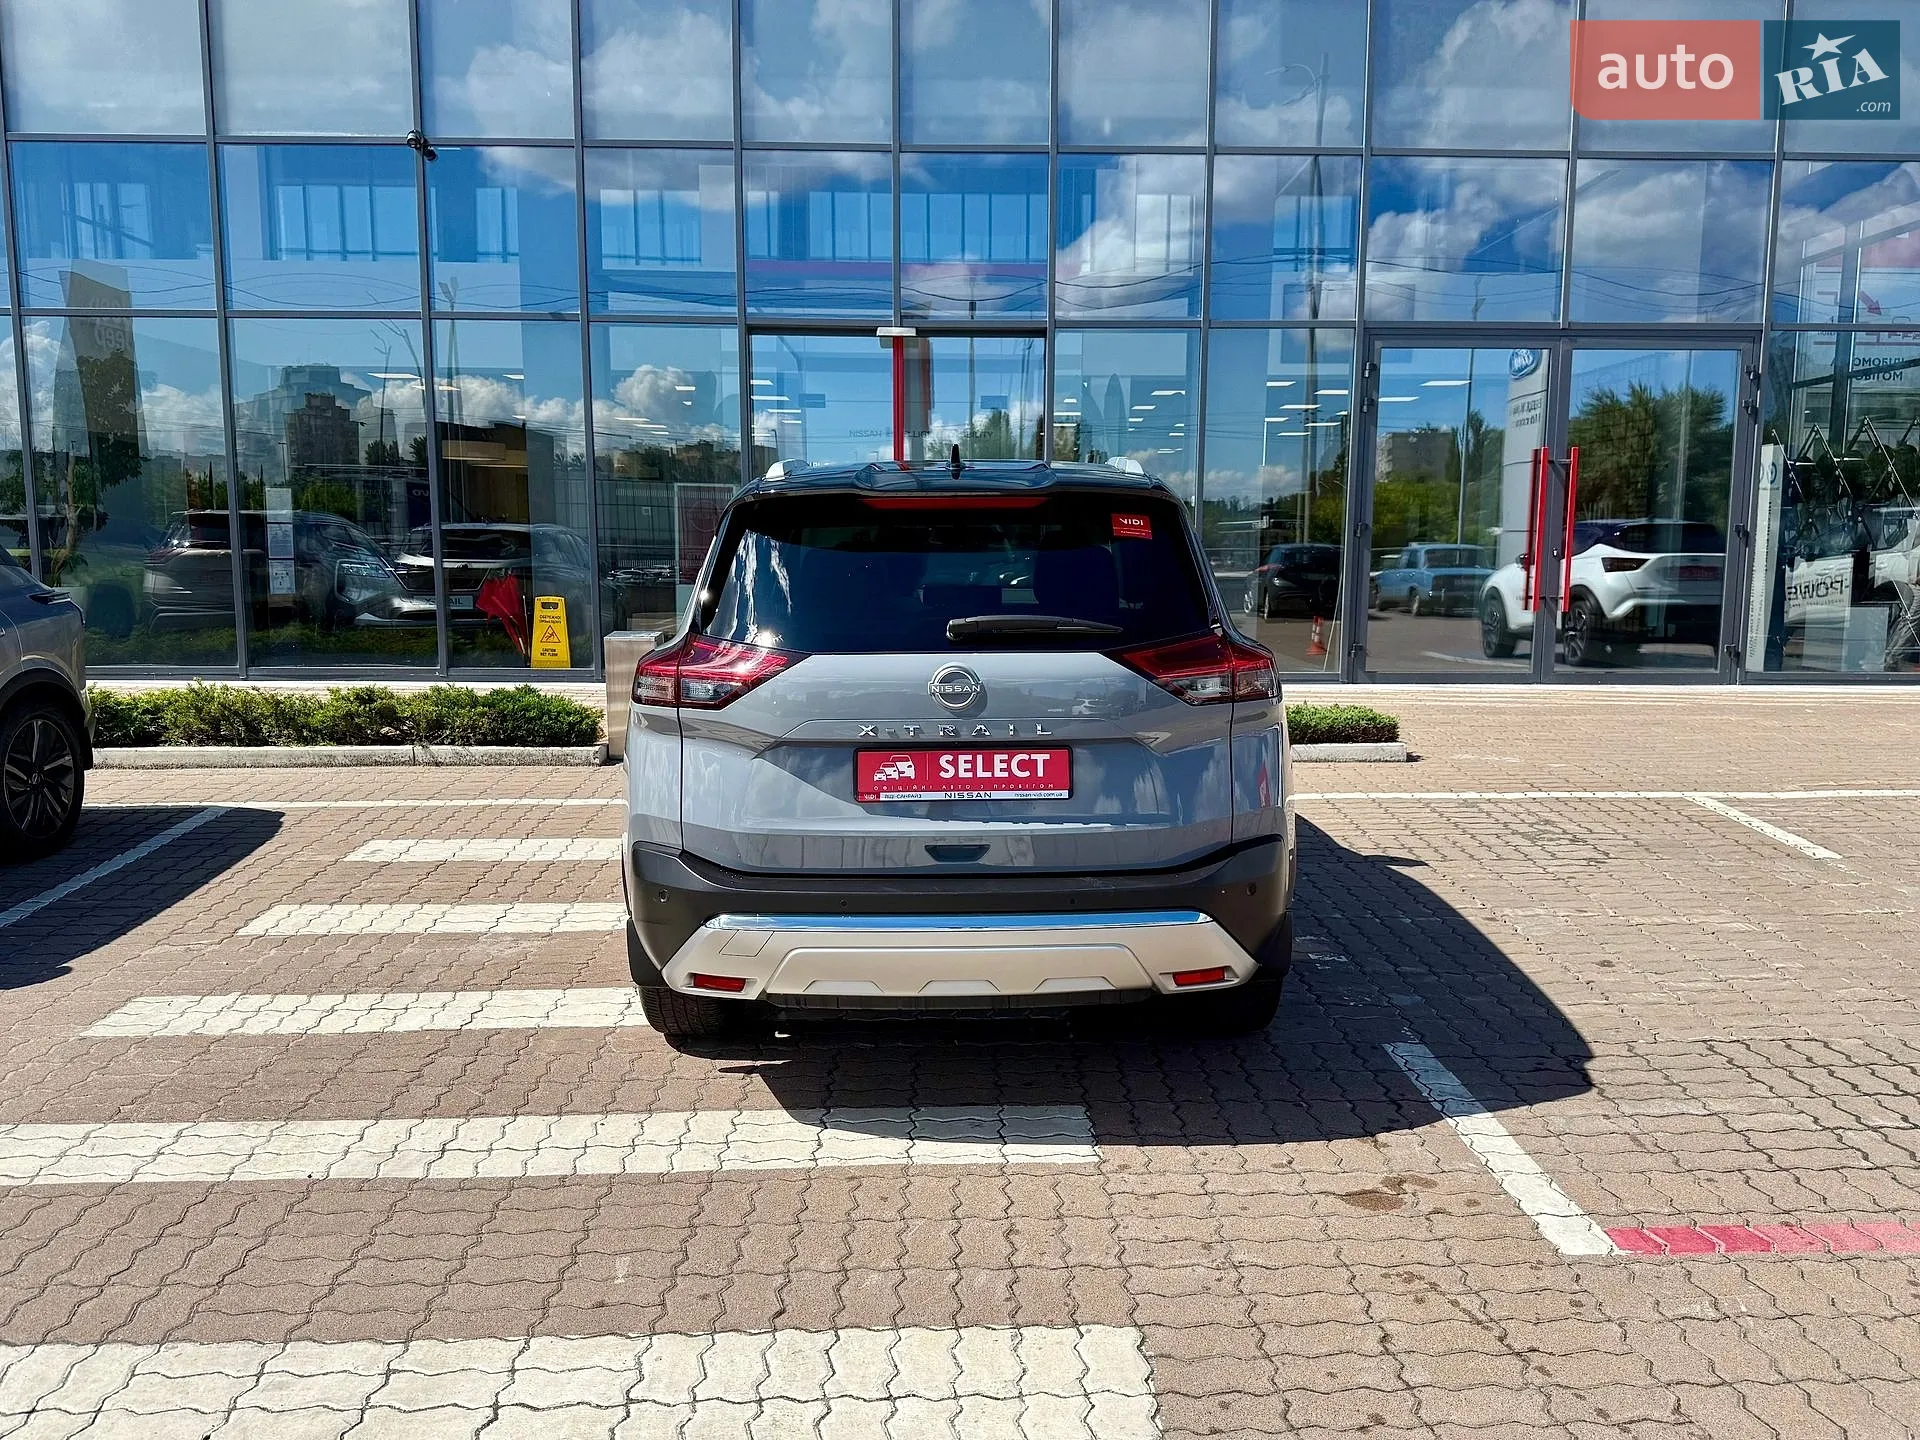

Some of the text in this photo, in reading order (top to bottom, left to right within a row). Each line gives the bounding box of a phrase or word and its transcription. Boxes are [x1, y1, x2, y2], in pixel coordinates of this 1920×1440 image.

[1119, 518, 1144, 526] VIDI
[930, 683, 981, 693] NISSAN
[857, 723, 1052, 736] X-TRAIL
[938, 753, 1051, 779] SELECT
[944, 791, 992, 799] NISSAN
